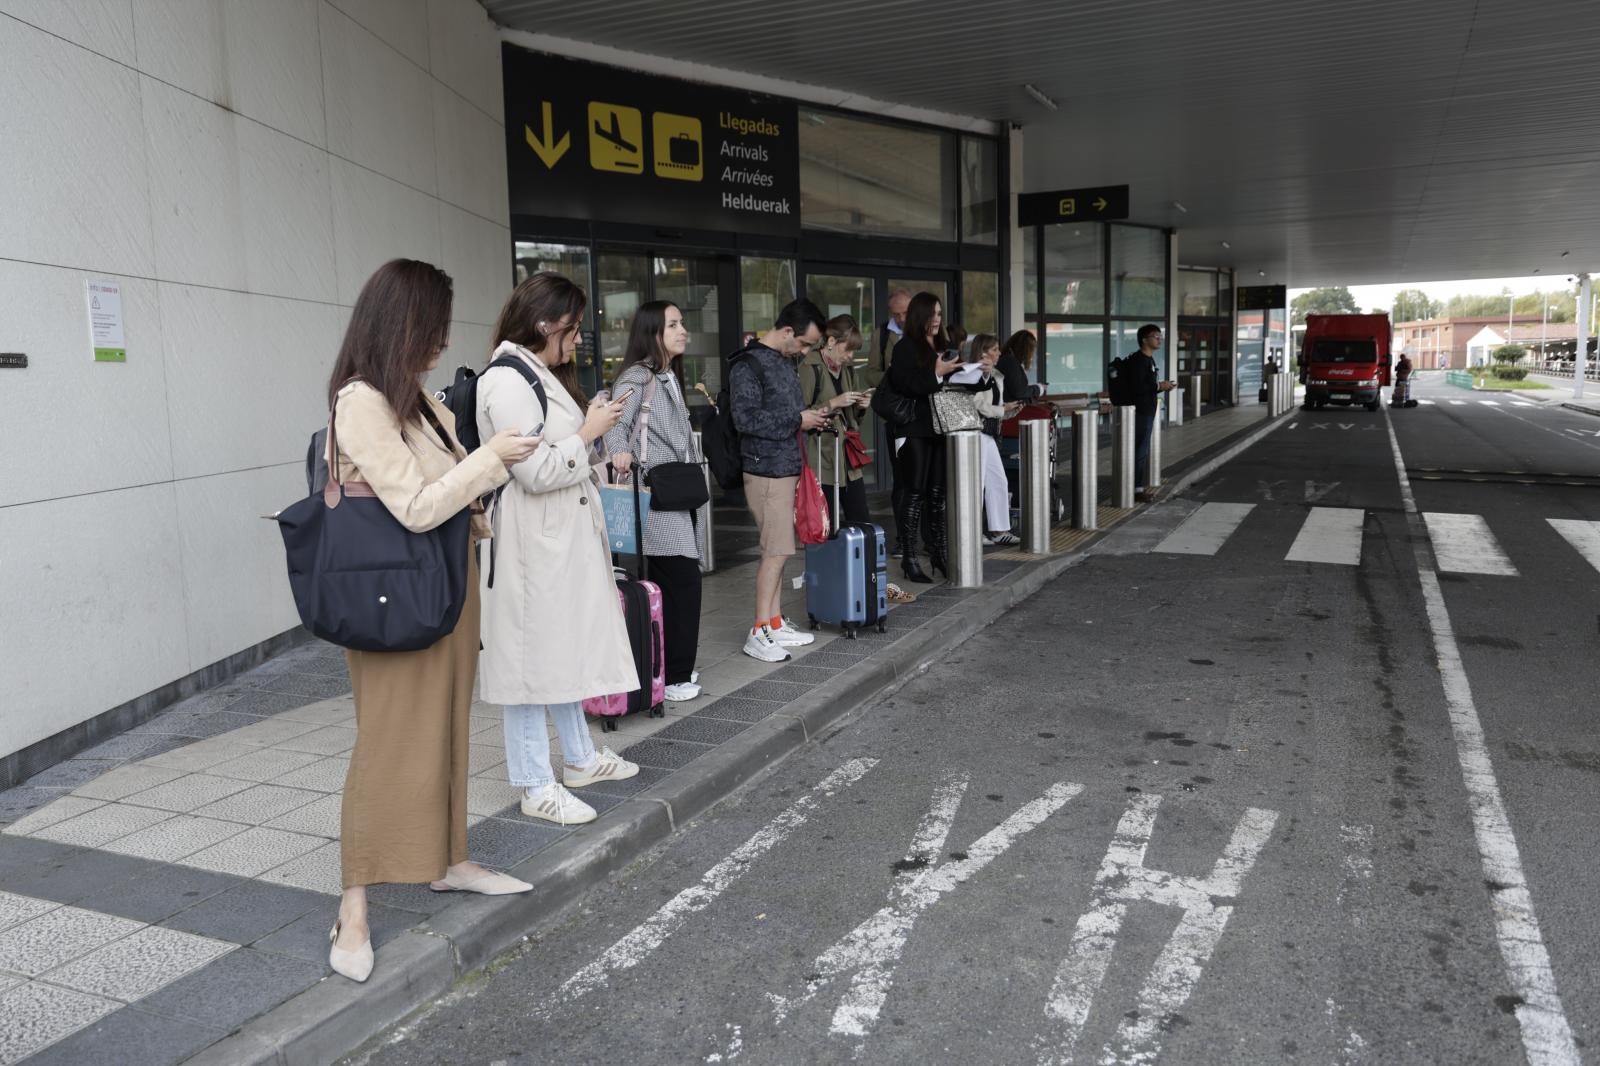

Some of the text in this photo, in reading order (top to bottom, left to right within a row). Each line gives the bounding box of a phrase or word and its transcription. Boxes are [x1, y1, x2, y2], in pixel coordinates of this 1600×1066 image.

[720, 111, 780, 136] Llegadas
[720, 140, 769, 162] Arrivals
[721, 166, 774, 187] Arrivées
[722, 192, 791, 214] Helduerak
